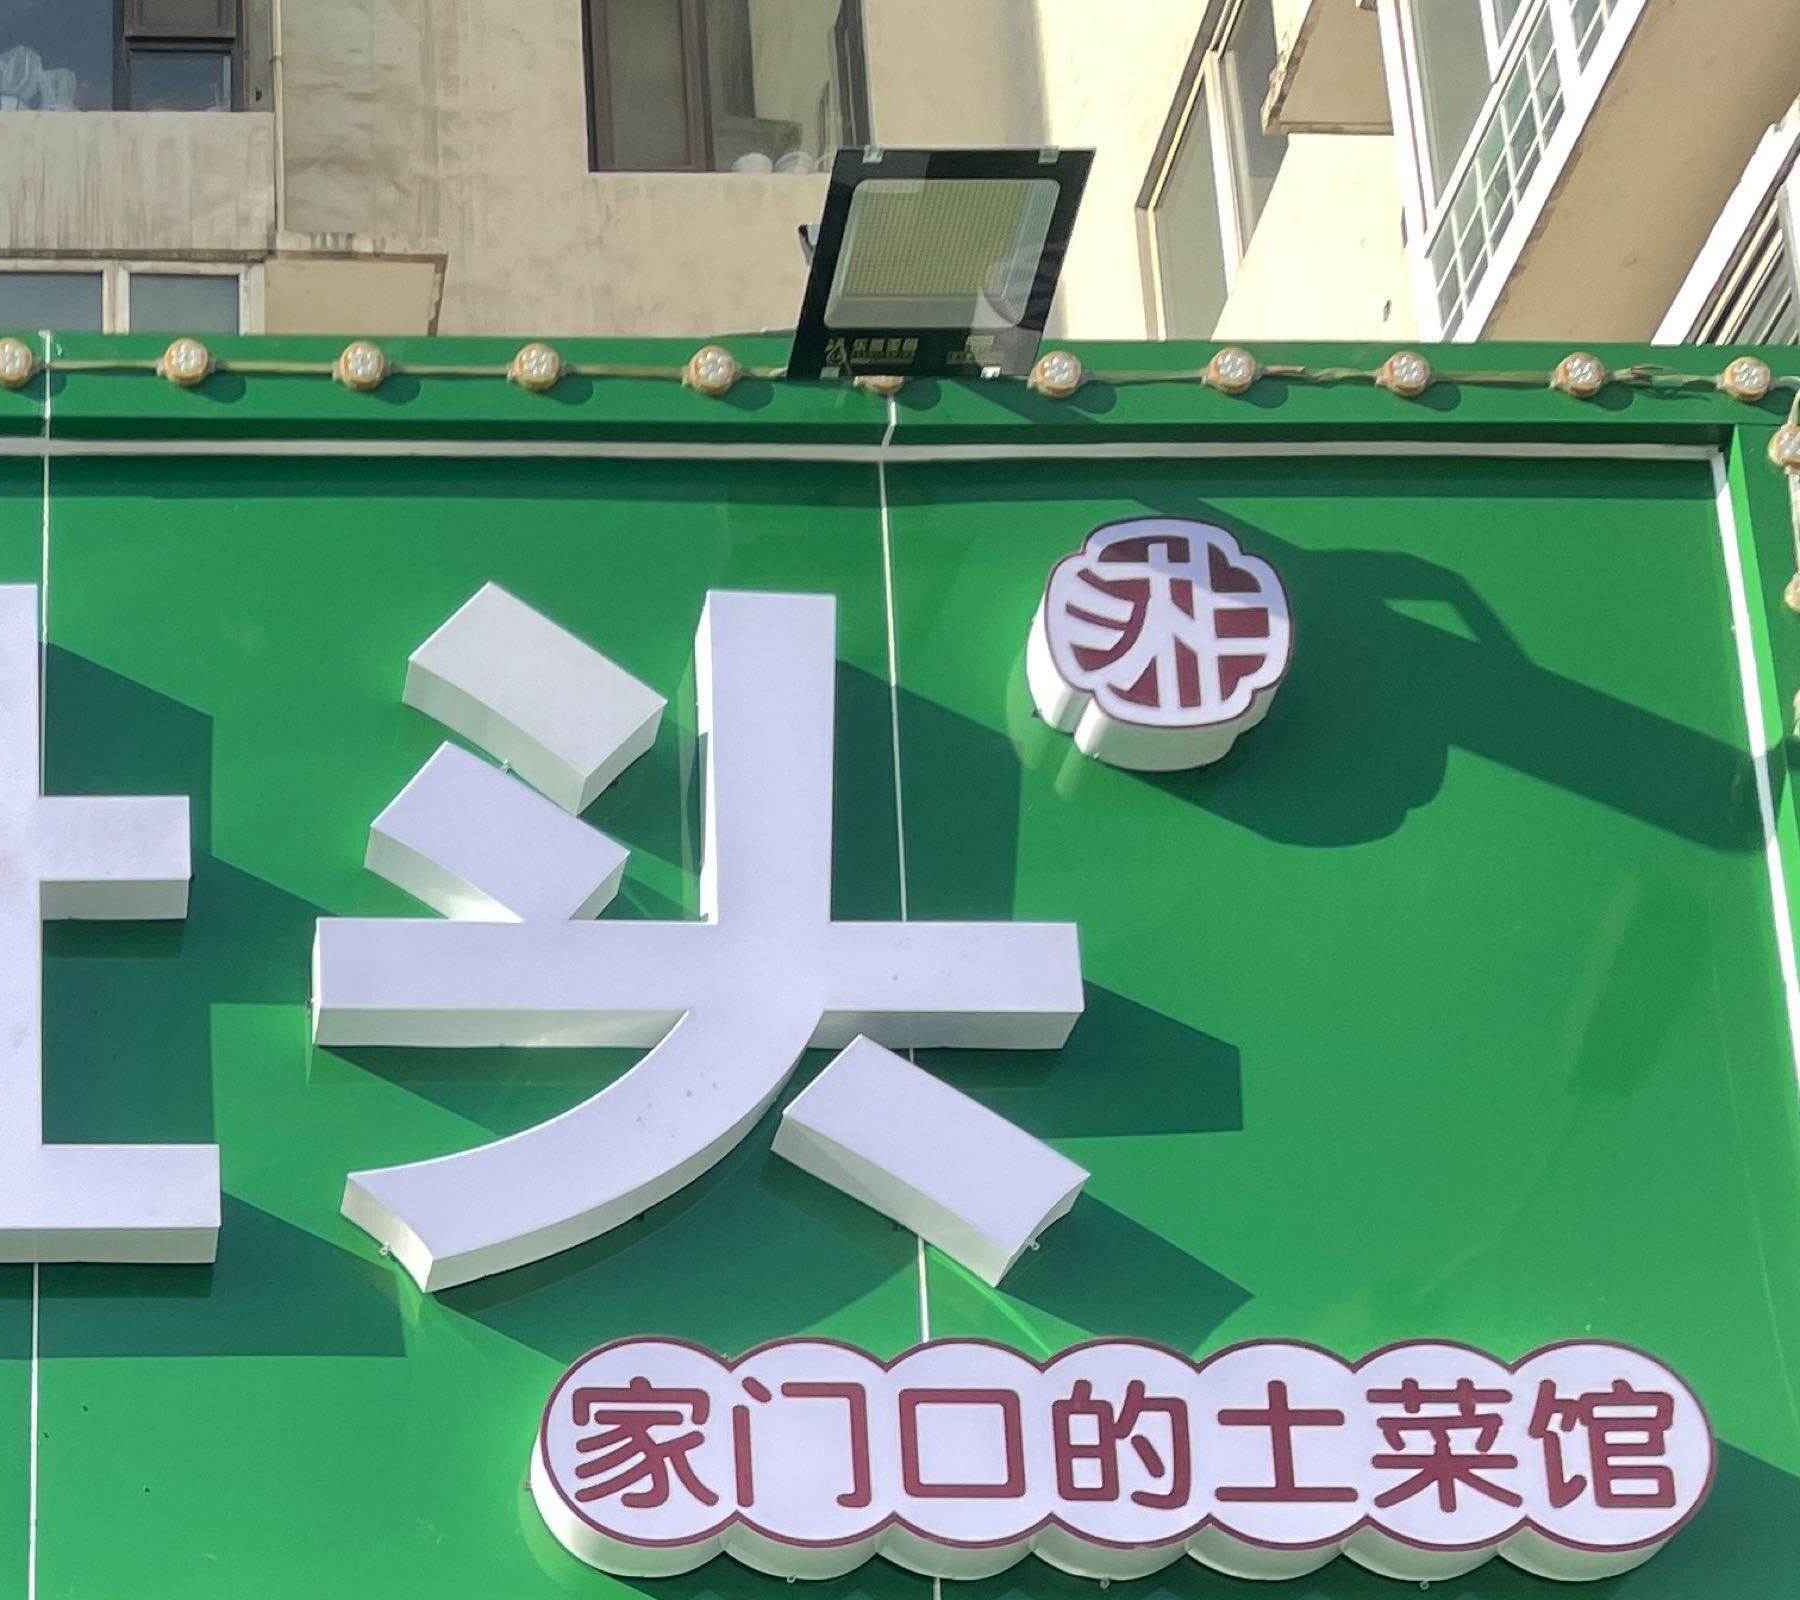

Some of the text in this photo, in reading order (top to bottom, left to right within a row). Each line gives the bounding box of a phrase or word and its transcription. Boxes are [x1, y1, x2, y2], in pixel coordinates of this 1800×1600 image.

[574, 1376, 1675, 1512] 家门口的土菜馆
